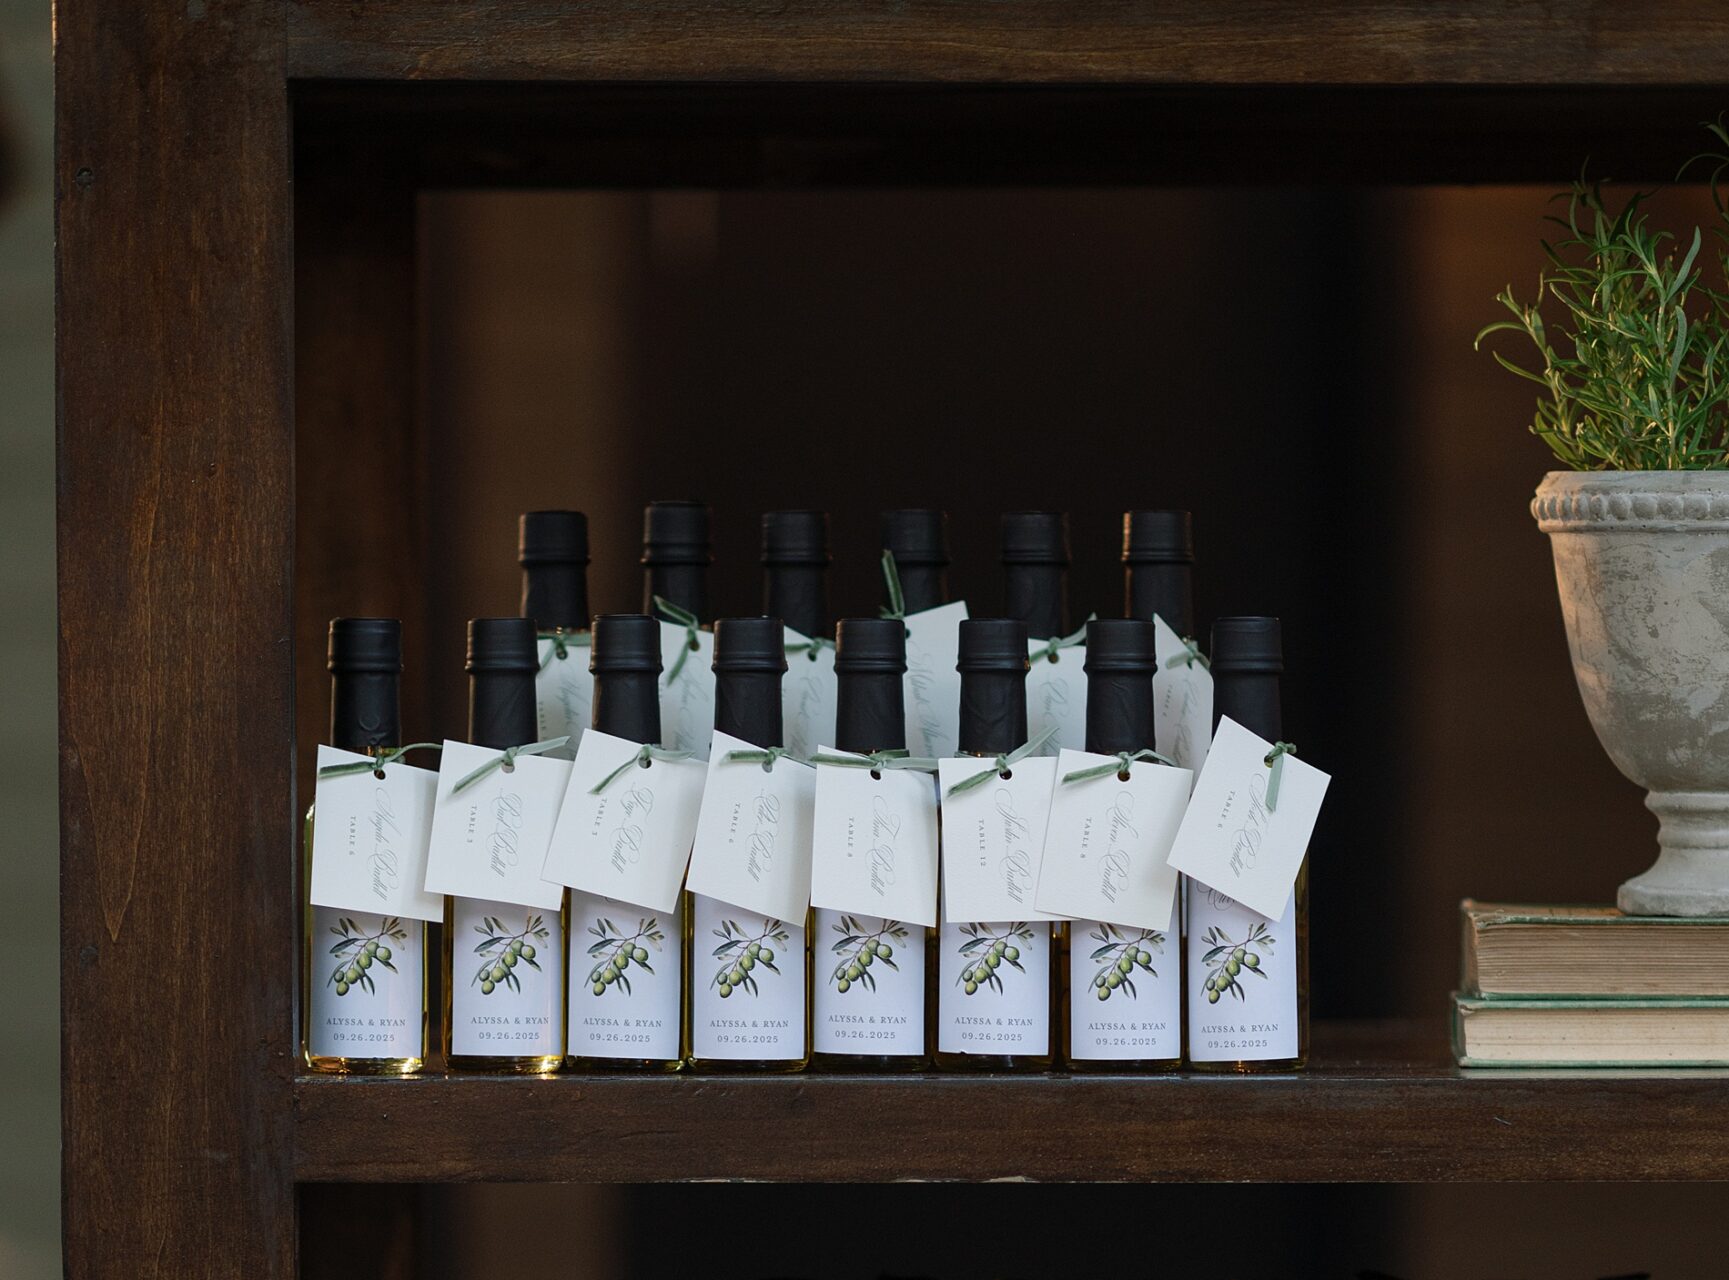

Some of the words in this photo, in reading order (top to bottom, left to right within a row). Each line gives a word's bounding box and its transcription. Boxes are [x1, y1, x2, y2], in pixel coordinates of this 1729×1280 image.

[1221, 790, 1236, 820] TABLE
[594, 798, 608, 827] TABLE
[730, 803, 742, 833] TABLE
[468, 806, 478, 834] TABLE
[349, 815, 357, 846] TABLE
[847, 817, 855, 848] TABLE
[978, 819, 986, 851] TABLE
[1081, 817, 1093, 849] TABLE
[326, 1017, 365, 1027] ALYSSA
[379, 1018, 406, 1028] RYAN
[470, 1016, 510, 1025] ALYSSA
[525, 1016, 549, 1025] RYAN
[583, 1016, 620, 1027] ALYSSA
[634, 1018, 662, 1028] RYAN
[709, 1019, 748, 1029] ALYSSA
[763, 1019, 790, 1029] RYAN
[828, 1014, 865, 1024] ALYSSA
[879, 1015, 907, 1025] RYAN
[954, 1016, 992, 1026] ALYSSA
[1007, 1018, 1033, 1027] RYAN
[1087, 1022, 1126, 1032] ALYSSA
[1141, 1022, 1168, 1032] RYAN
[1201, 1024, 1236, 1034] ALYSSA
[1250, 1023, 1279, 1033] RYAN
[333, 1031, 396, 1042] 09.26.2025
[478, 1031, 540, 1040] 09.26.2025
[589, 1031, 651, 1043] 09.26.2025
[716, 1032, 779, 1044] 09.26.2025
[834, 1029, 896, 1040] 09.26.2025
[961, 1031, 1025, 1042] 09.26.2025
[1095, 1037, 1157, 1048] 09.26.2025
[1207, 1039, 1268, 1049] 09.26.2025
